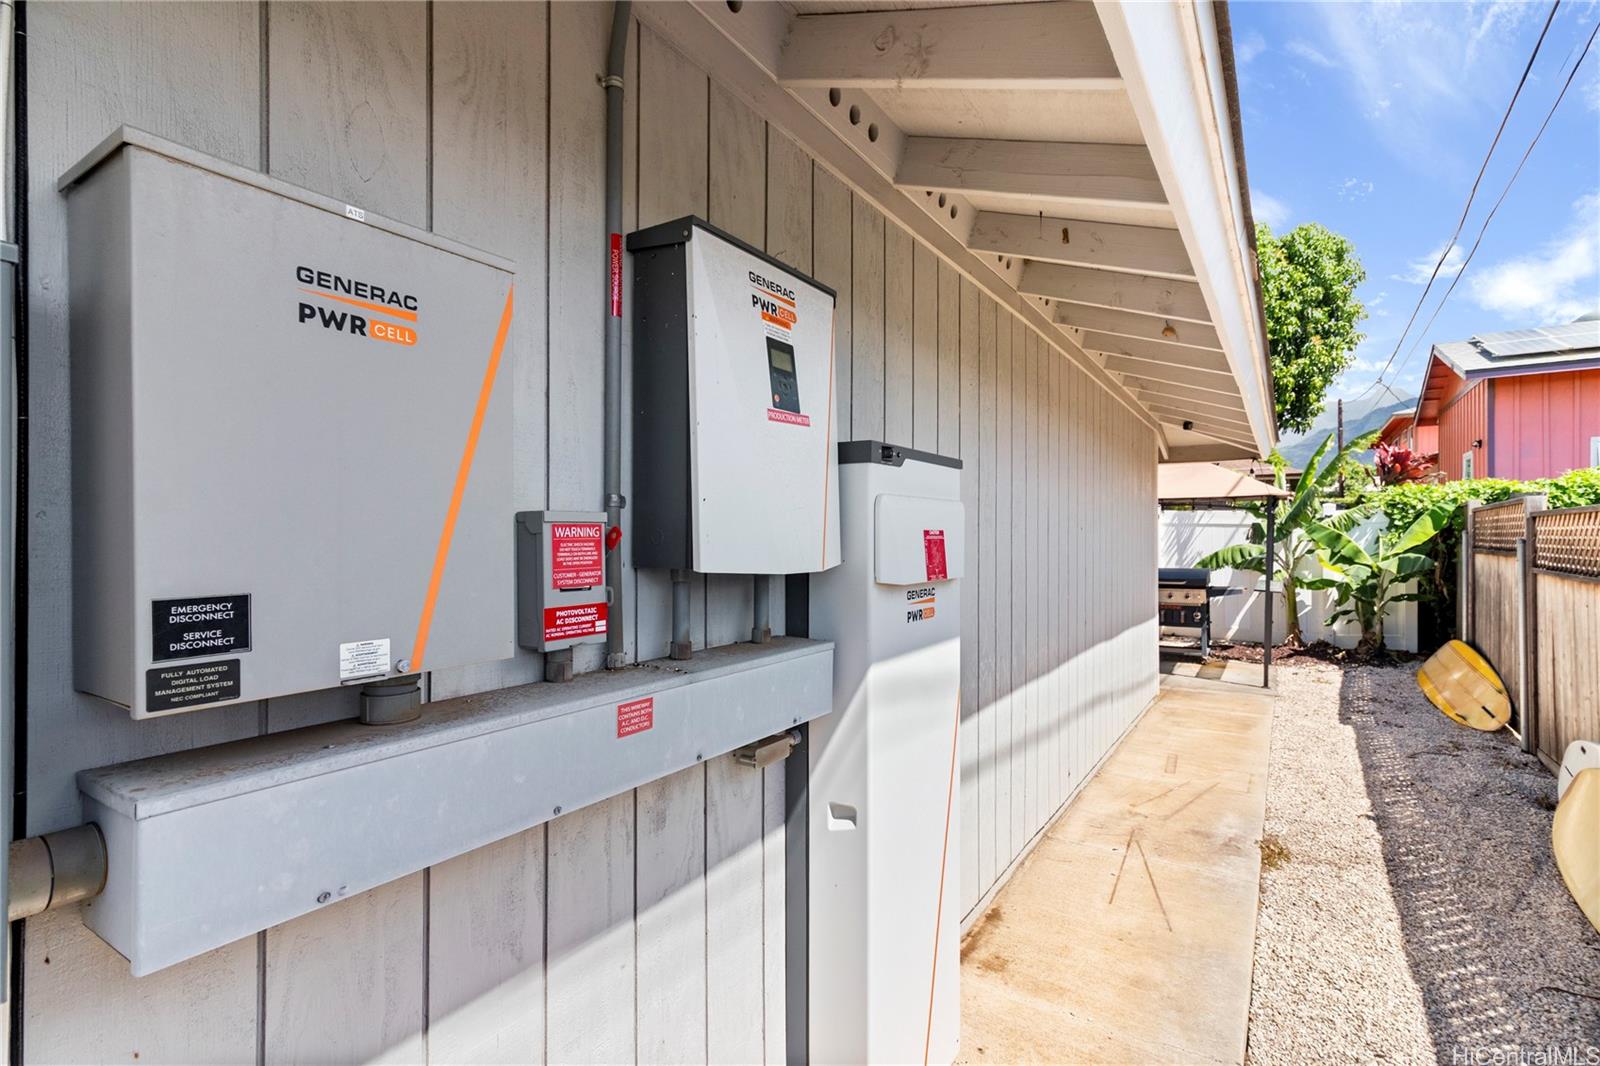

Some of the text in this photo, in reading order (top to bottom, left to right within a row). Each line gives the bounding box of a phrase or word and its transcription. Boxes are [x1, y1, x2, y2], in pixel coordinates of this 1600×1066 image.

[348, 208, 364, 219] ATS
[296, 266, 418, 311] GENERAC
[749, 271, 796, 300] GENERAC
[752, 294, 778, 316] PWR
[298, 302, 366, 336] PWR
[554, 526, 600, 538] WARNING
[906, 588, 936, 600] GENERAC
[171, 602, 232, 614] EMERGENCY
[556, 607, 597, 617] PHOTOVOLTAIC
[169, 611, 234, 624] DISCONNECT
[565, 614, 598, 624] DISCONNECT
[907, 608, 923, 623] PWR
[183, 630, 222, 641] SERVICE
[170, 637, 235, 652] DISCONNECT
[186, 666, 228, 676] AUTOMATED
[155, 680, 233, 696] MANAGEMENT SYSTEM
[171, 678, 198, 686] DIGITAL
[185, 691, 219, 700] COMPLIANT
[618, 710, 640, 720] CONTAINS
[620, 721, 650, 734] CONDUCTORS
